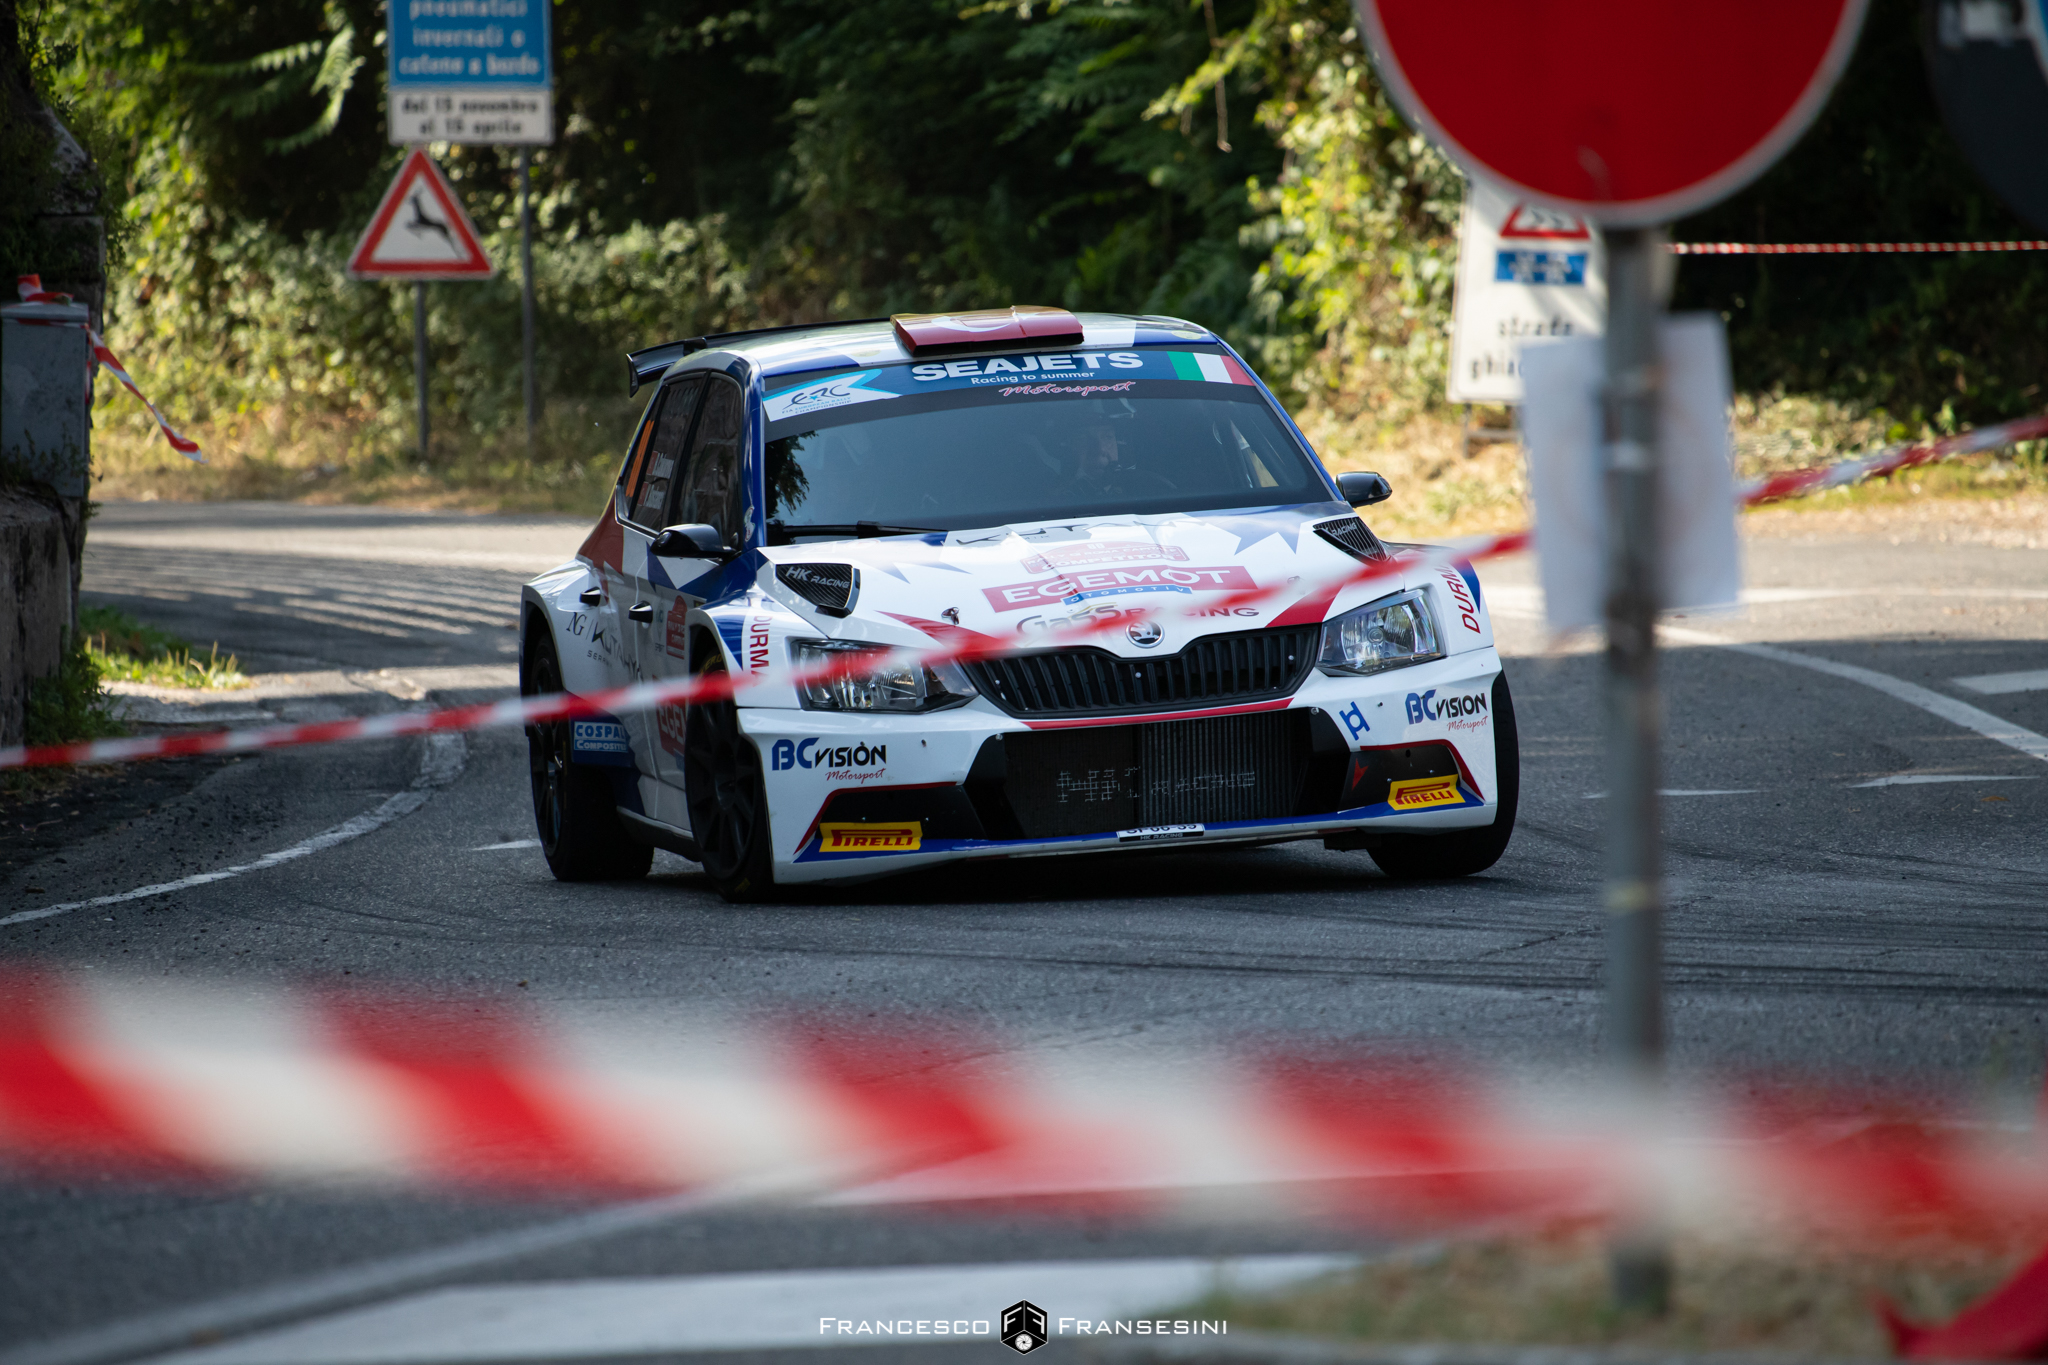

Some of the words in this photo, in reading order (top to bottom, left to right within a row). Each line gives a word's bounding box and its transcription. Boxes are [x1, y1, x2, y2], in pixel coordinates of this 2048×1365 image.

[911, 352, 1144, 381] SEAJETS
[971, 374, 1018, 385] Racing
[1023, 373, 1036, 381] to
[1040, 370, 1095, 380] summer
[998, 381, 1136, 396] Motorsport
[785, 566, 812, 581] HK
[810, 575, 850, 589] RACING
[1001, 569, 1231, 604] EGEMOT
[1447, 715, 1489, 733] Motorsport
[825, 768, 887, 784] Motorsport
[1395, 781, 1455, 806] PIRELLI
[831, 829, 913, 847] PIRELLI
